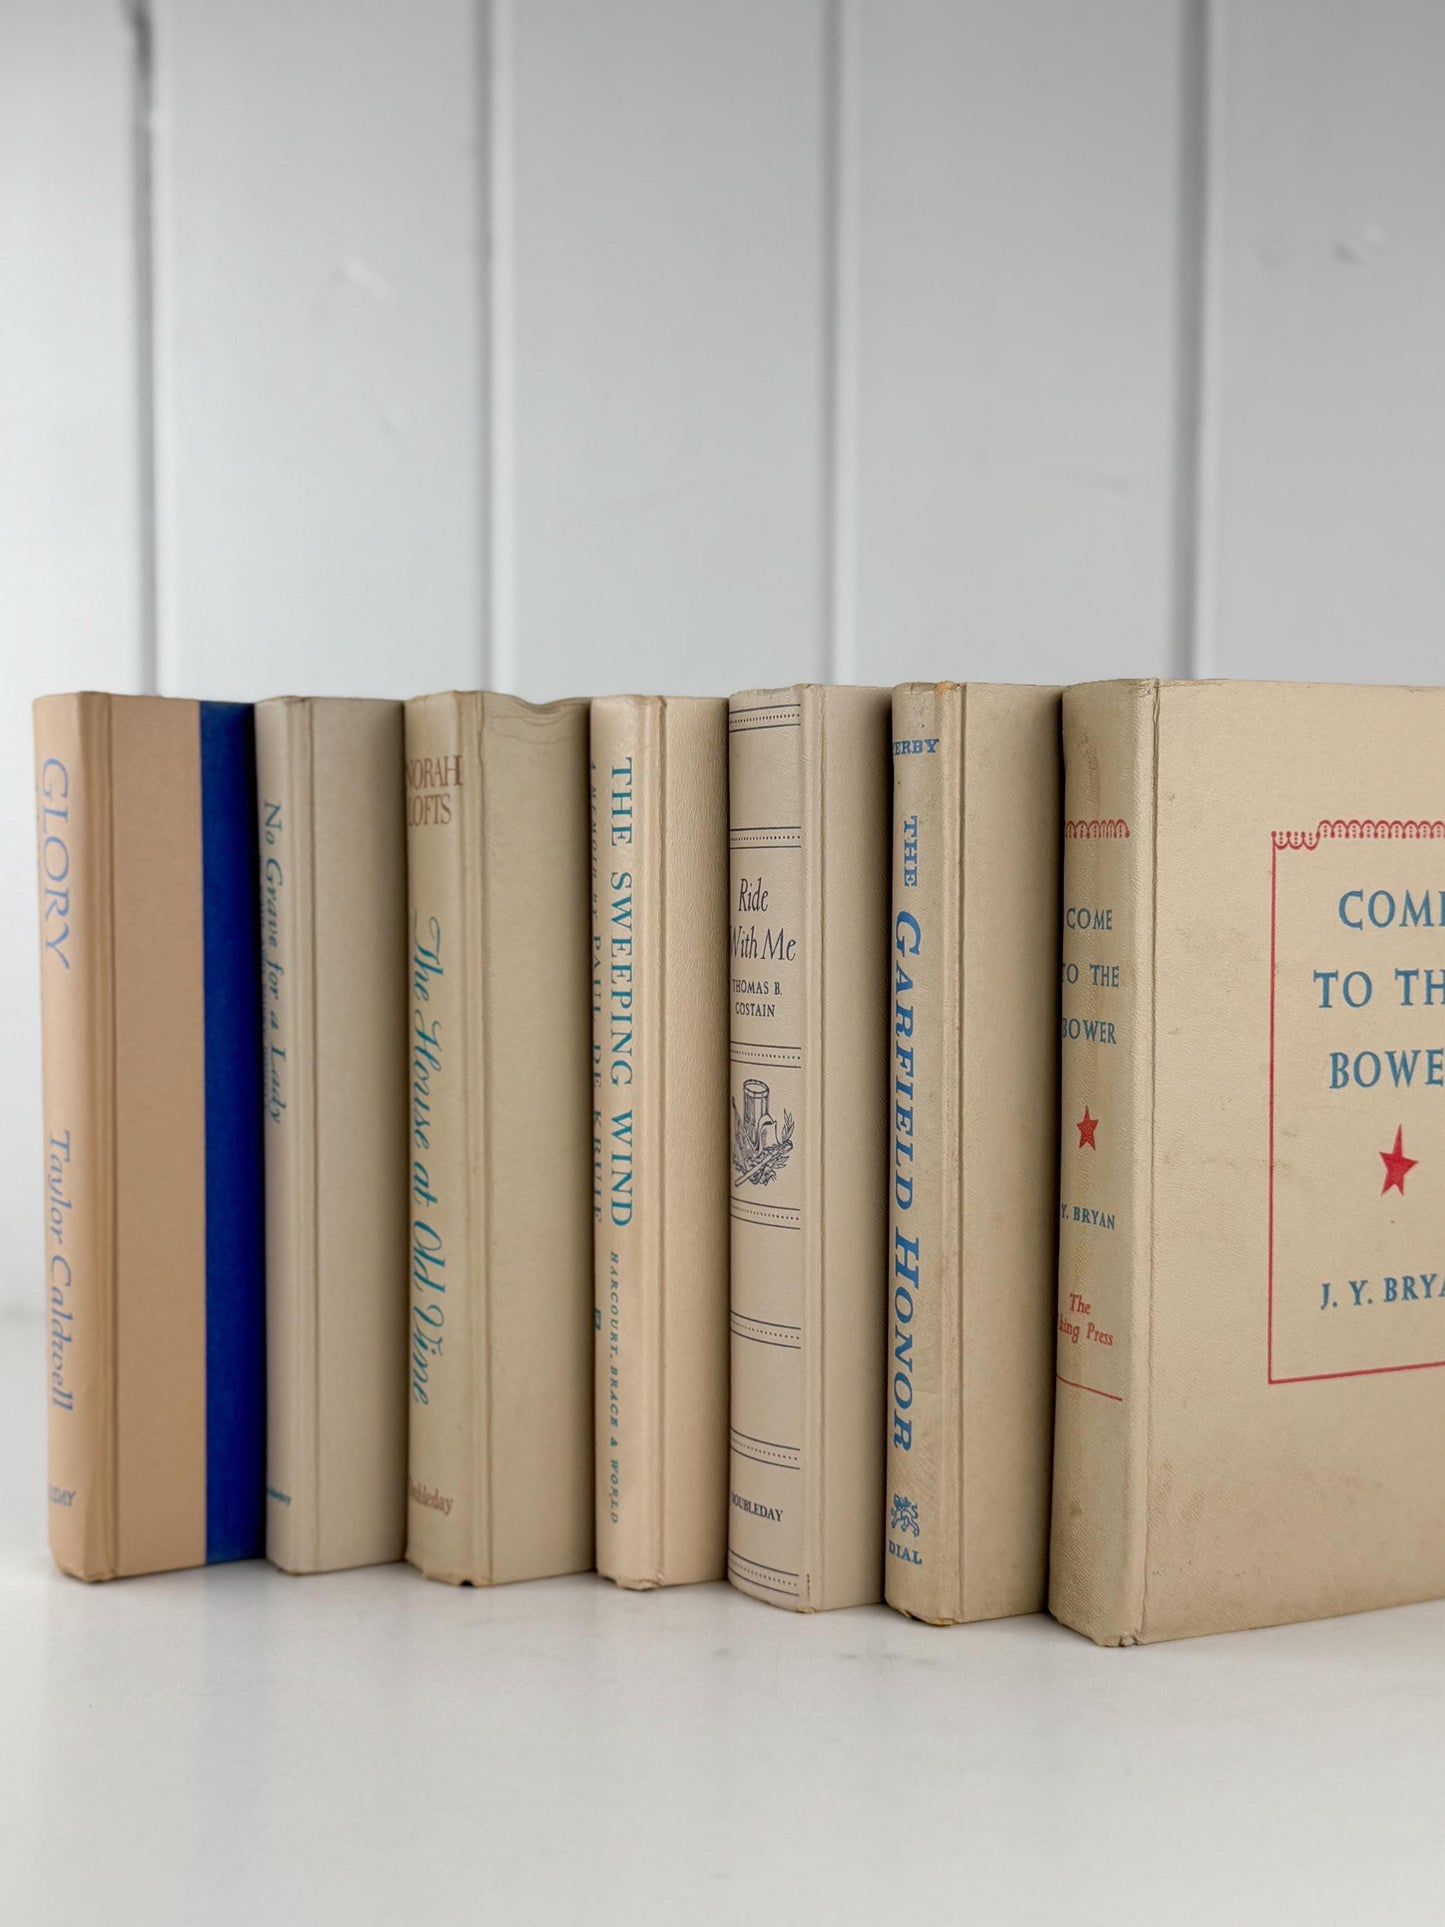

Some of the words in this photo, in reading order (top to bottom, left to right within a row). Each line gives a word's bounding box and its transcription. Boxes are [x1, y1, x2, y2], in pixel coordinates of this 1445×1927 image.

[264, 802, 282, 845] No
[611, 757, 632, 847] THE
[42, 758, 70, 969] GLORY
[903, 815, 918, 887] THE
[265, 858, 283, 948] Grave
[738, 877, 768, 912] Ride
[1066, 908, 1113, 930] COME
[413, 908, 444, 1001] The
[761, 928, 796, 961] Me
[1089, 964, 1120, 987] THE
[264, 959, 284, 1000] for
[610, 871, 632, 1086] SWEEPING
[732, 979, 769, 995] THOMAS
[774, 982, 783, 996] B.
[735, 1002, 775, 1018] COSTAIN
[1313, 970, 1373, 1009] TO
[269, 1010, 279, 1031] a
[270, 1043, 286, 1123] Lady
[413, 1009, 442, 1149] House
[895, 910, 922, 1210] GARFIELD
[48, 1130, 72, 1244] Taylor
[413, 1161, 437, 1206] at
[610, 1109, 632, 1226] WIND
[1073, 1206, 1115, 1230] BRYAN
[413, 1220, 446, 1292] Old
[1070, 1293, 1091, 1315] The
[1320, 1282, 1337, 1310] J.
[1348, 1279, 1373, 1306] Y.
[50, 1255, 74, 1411] Caldwell
[413, 1304, 445, 1405] Vine
[893, 1225, 920, 1451] HONOR
[1086, 1322, 1114, 1346] Press
[610, 1365, 618, 1428] BRACE
[610, 1459, 619, 1523] WORLD
[888, 1539, 923, 1565] DIAL
